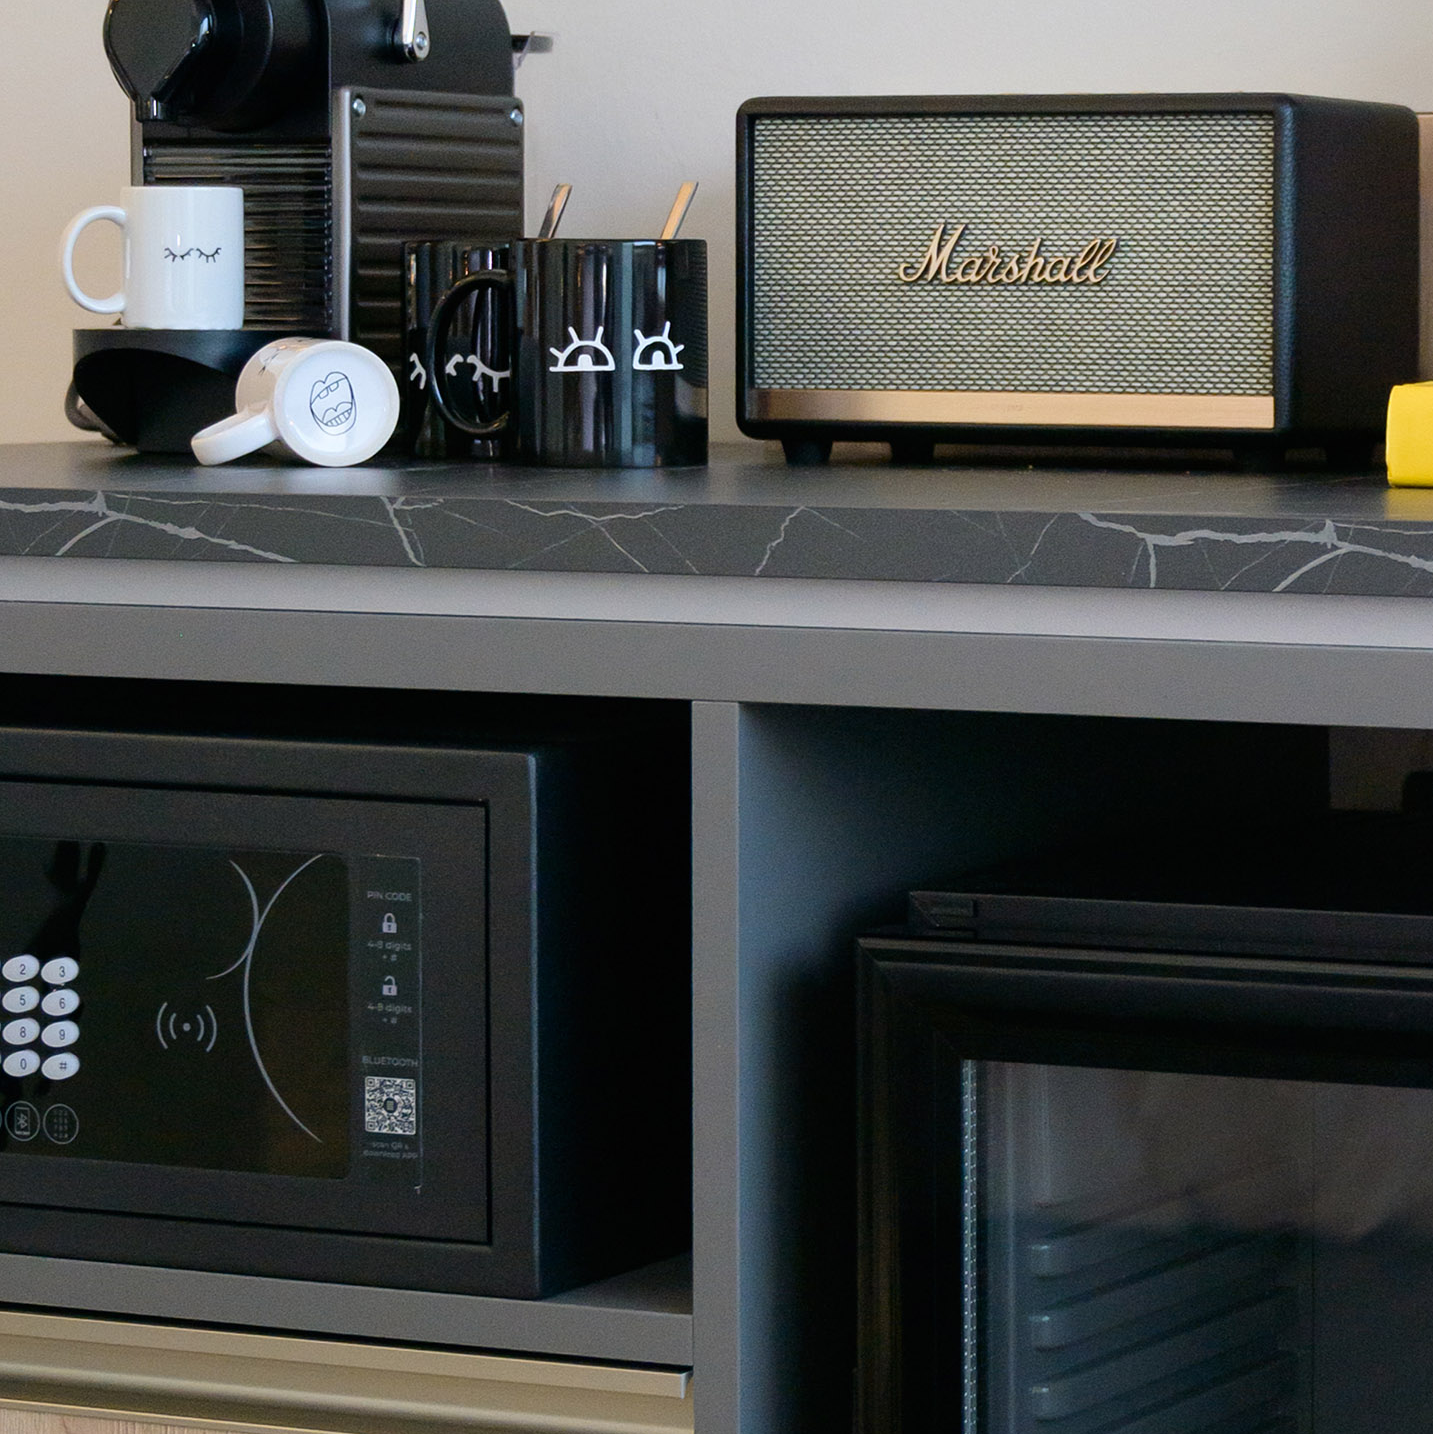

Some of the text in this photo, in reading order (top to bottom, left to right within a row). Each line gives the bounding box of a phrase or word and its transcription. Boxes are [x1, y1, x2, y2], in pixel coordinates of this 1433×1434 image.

[898, 223, 1118, 285] Marshall
[367, 890, 413, 902] PIN CODE
[385, 940, 412, 952] digits
[20, 963, 66, 978] 2 3
[20, 994, 66, 1010] 5 6
[385, 1003, 412, 1014] digits
[20, 1026, 66, 1041] 8 9
[20, 1058, 27, 1070] 0
[362, 1055, 419, 1067] BLUETOOTH
